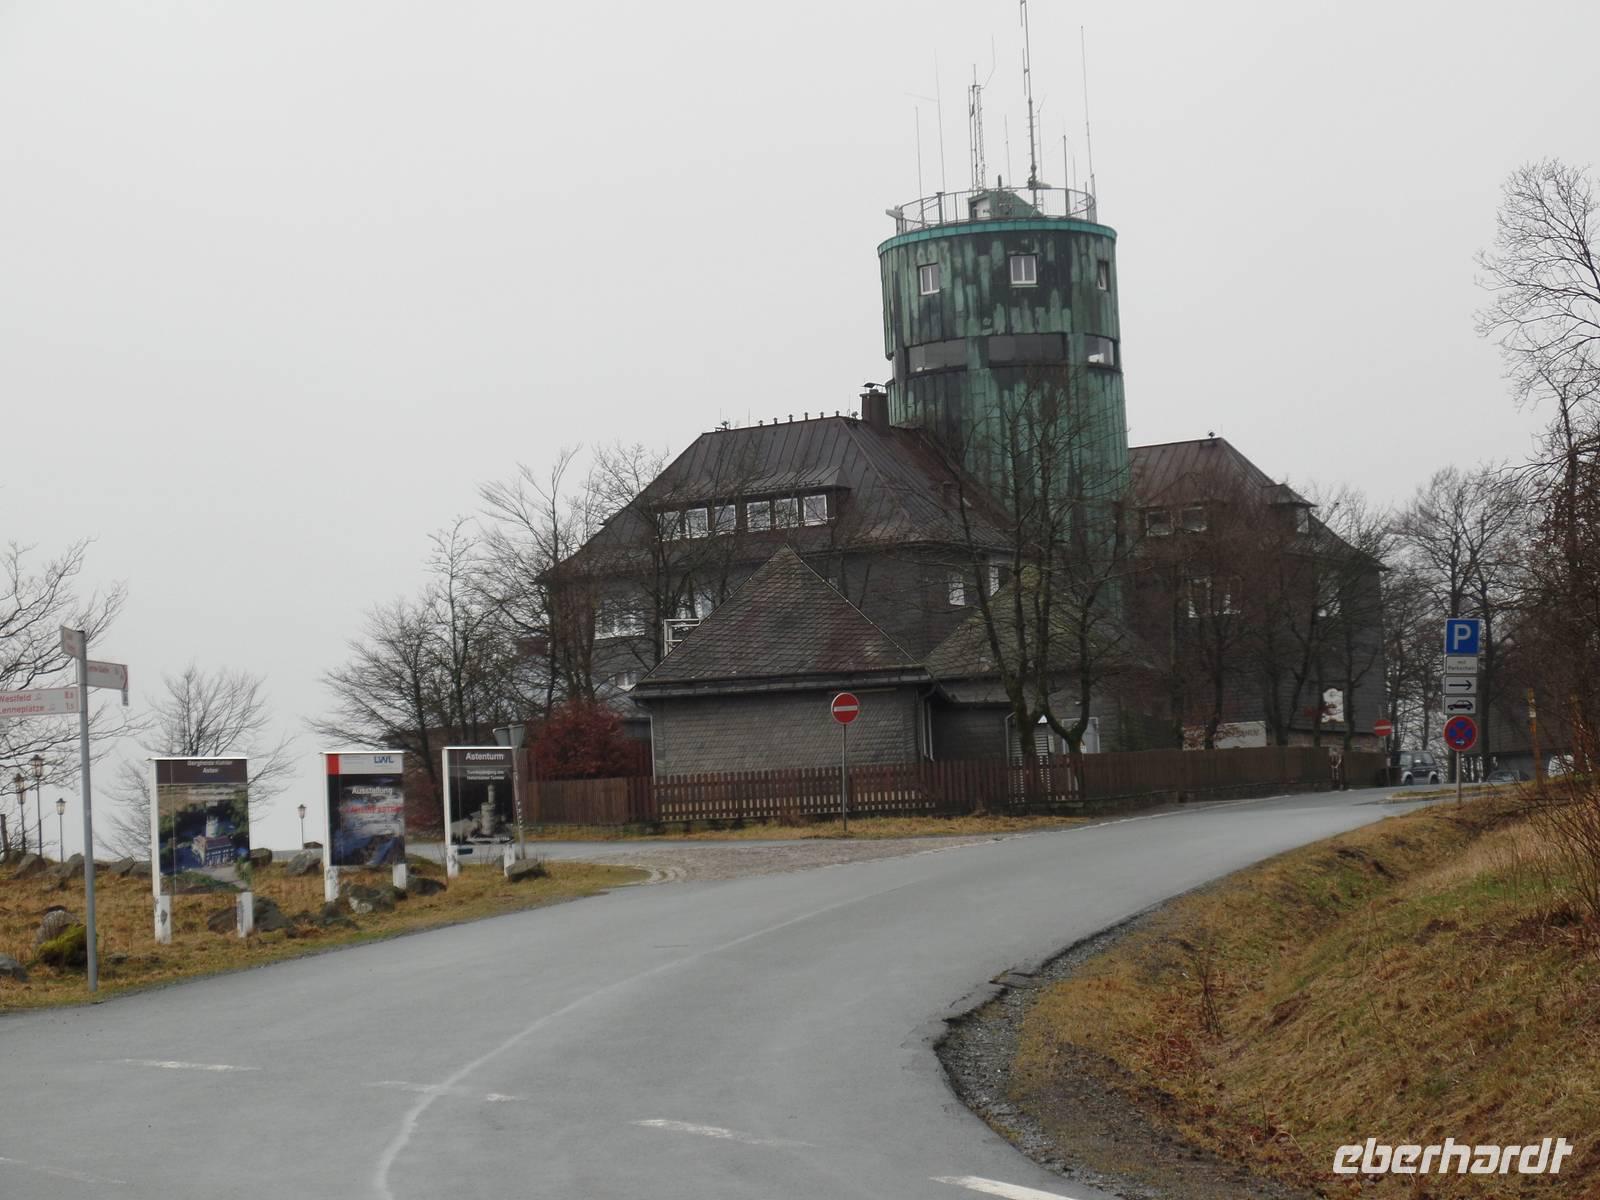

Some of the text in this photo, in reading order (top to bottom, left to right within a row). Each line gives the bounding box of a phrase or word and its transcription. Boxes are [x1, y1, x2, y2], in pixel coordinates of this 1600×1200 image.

[1453, 624, 1471, 650] P
[465, 751, 505, 761] Astenturm
[352, 786, 393, 795] Ausstellung
